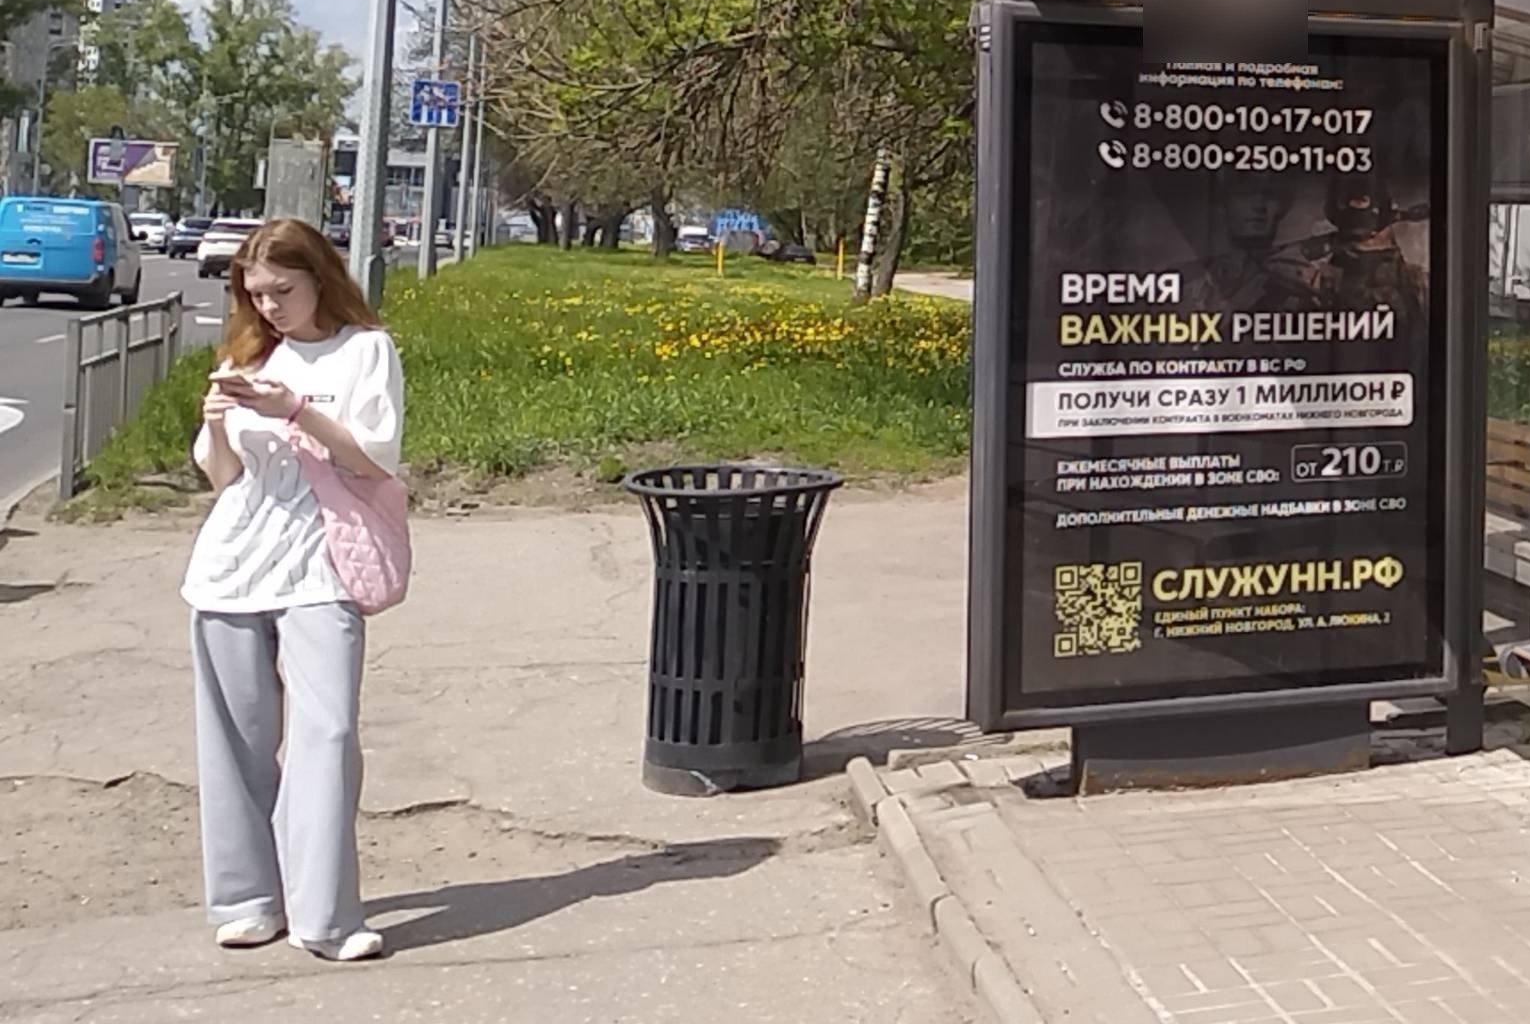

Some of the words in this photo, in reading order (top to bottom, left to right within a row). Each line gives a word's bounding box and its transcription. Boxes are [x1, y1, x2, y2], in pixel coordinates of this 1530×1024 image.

[1139, 70, 1235, 87] информация
[1238, 76, 1256, 88] по
[1238, 62, 1319, 76] подробная
[1061, 272, 1180, 304] ВРЕМЯ
[1060, 313, 1222, 345] ВАЖНЫХ
[1232, 304, 1394, 342] РЕШЕНИЙ
[1058, 360, 1126, 376] СЛУЖБА
[1129, 360, 1153, 375] ПО
[1155, 358, 1244, 375] КОНТРАКТУ
[1247, 358, 1256, 373] В
[1260, 358, 1280, 373] ВС
[1284, 358, 1306, 372] РФ
[1058, 389, 1151, 411] ПОЛУЧИ
[1157, 387, 1230, 408] СРАЗУ
[1236, 385, 1246, 404] 1
[1255, 382, 1385, 404] МИЛЛИОН
[1058, 418, 1079, 427] ПРИ
[1152, 414, 1210, 425] КОНТРАКТА
[1344, 408, 1404, 418] НОВГОРОДА
[1057, 456, 1166, 474] ЕЖЕМЕСЯЧНЫЕ
[1169, 454, 1240, 470] ВЫПЛАТЫ
[1296, 462, 1318, 477] ОТ
[1321, 446, 1381, 476] 210
[1056, 477, 1086, 492] ПРИ
[1089, 474, 1192, 491] НАХОЖДЕНИИ
[1195, 473, 1204, 486] В
[1207, 471, 1244, 486] ЗОНЕ
[1246, 470, 1280, 484] СВО:
[1056, 508, 1184, 528] ДОПОЛНИТЕЛЬНЫЕ
[1186, 504, 1258, 521] ДЕНЕЖНЫЕ
[1262, 500, 1330, 517] НАДБАВКИ
[1333, 500, 1342, 513] В
[1344, 499, 1377, 513] ЗОНЕ
[1379, 497, 1406, 511] СВО
[1153, 557, 1403, 603] СЛУЖУНН.РФ
[1154, 606, 1209, 624] ЕДИНЫЙ
[1211, 605, 1253, 619] ПУНКТ
[1166, 621, 1223, 638] НИЖНИЙ
